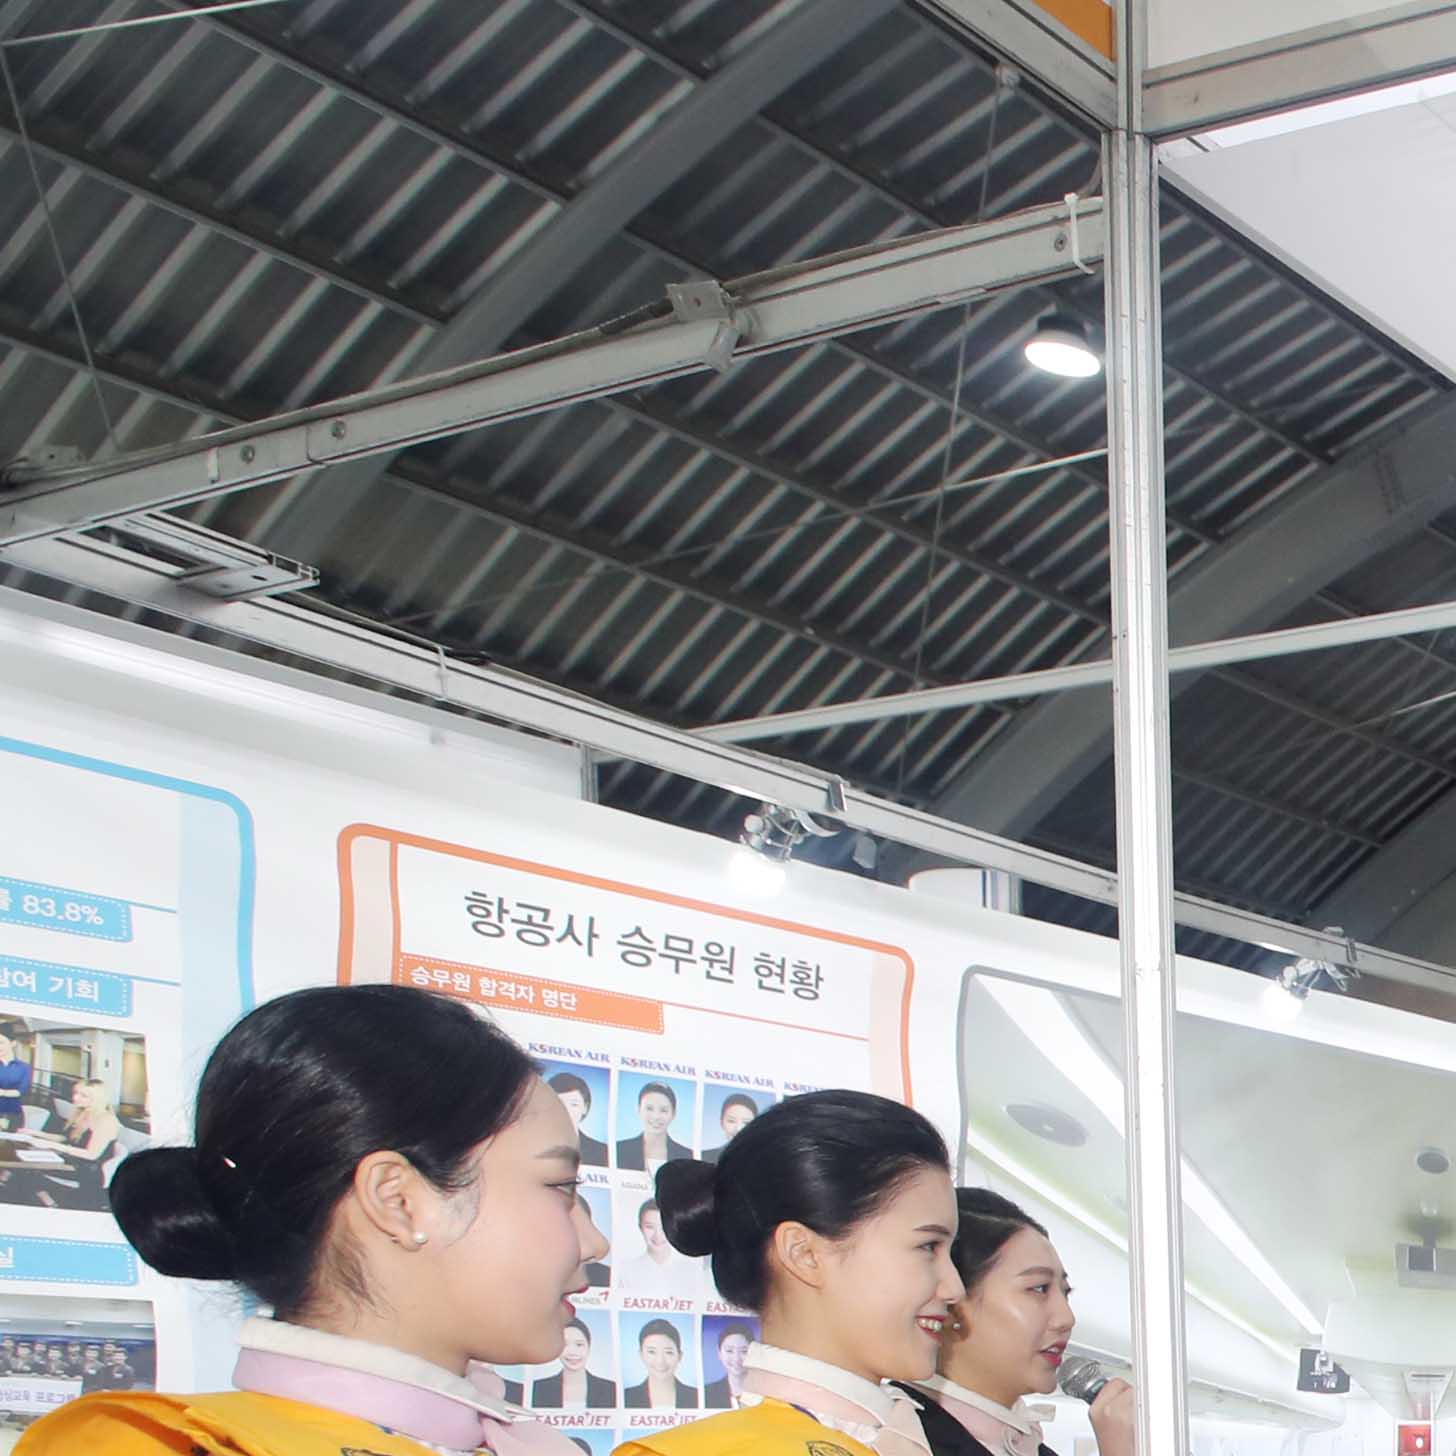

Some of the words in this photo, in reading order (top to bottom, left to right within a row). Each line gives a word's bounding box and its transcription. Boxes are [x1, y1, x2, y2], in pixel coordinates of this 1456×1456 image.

[23, 894, 105, 926] 83.8%
[464, 891, 599, 958] 항공사
[617, 924, 736, 983] 승무원
[752, 951, 824, 1001] 현황
[48, 976, 100, 1003] 기회
[410, 965, 471, 992] 승무원
[480, 978, 536, 1003] 합격자
[541, 988, 578, 1011] 명단
[528, 1041, 582, 1059] KOREAN
[585, 1050, 611, 1063] AIR
[620, 1056, 672, 1072] KOREAN
[674, 1064, 697, 1077] AIR
[705, 1069, 751, 1085] KOREAN
[753, 1076, 775, 1089] AIR
[623, 1298, 670, 1311] EASTAR
[673, 1300, 695, 1311] JET
[589, 1415, 611, 1427] JET
[630, 1415, 676, 1427] EASTAR
